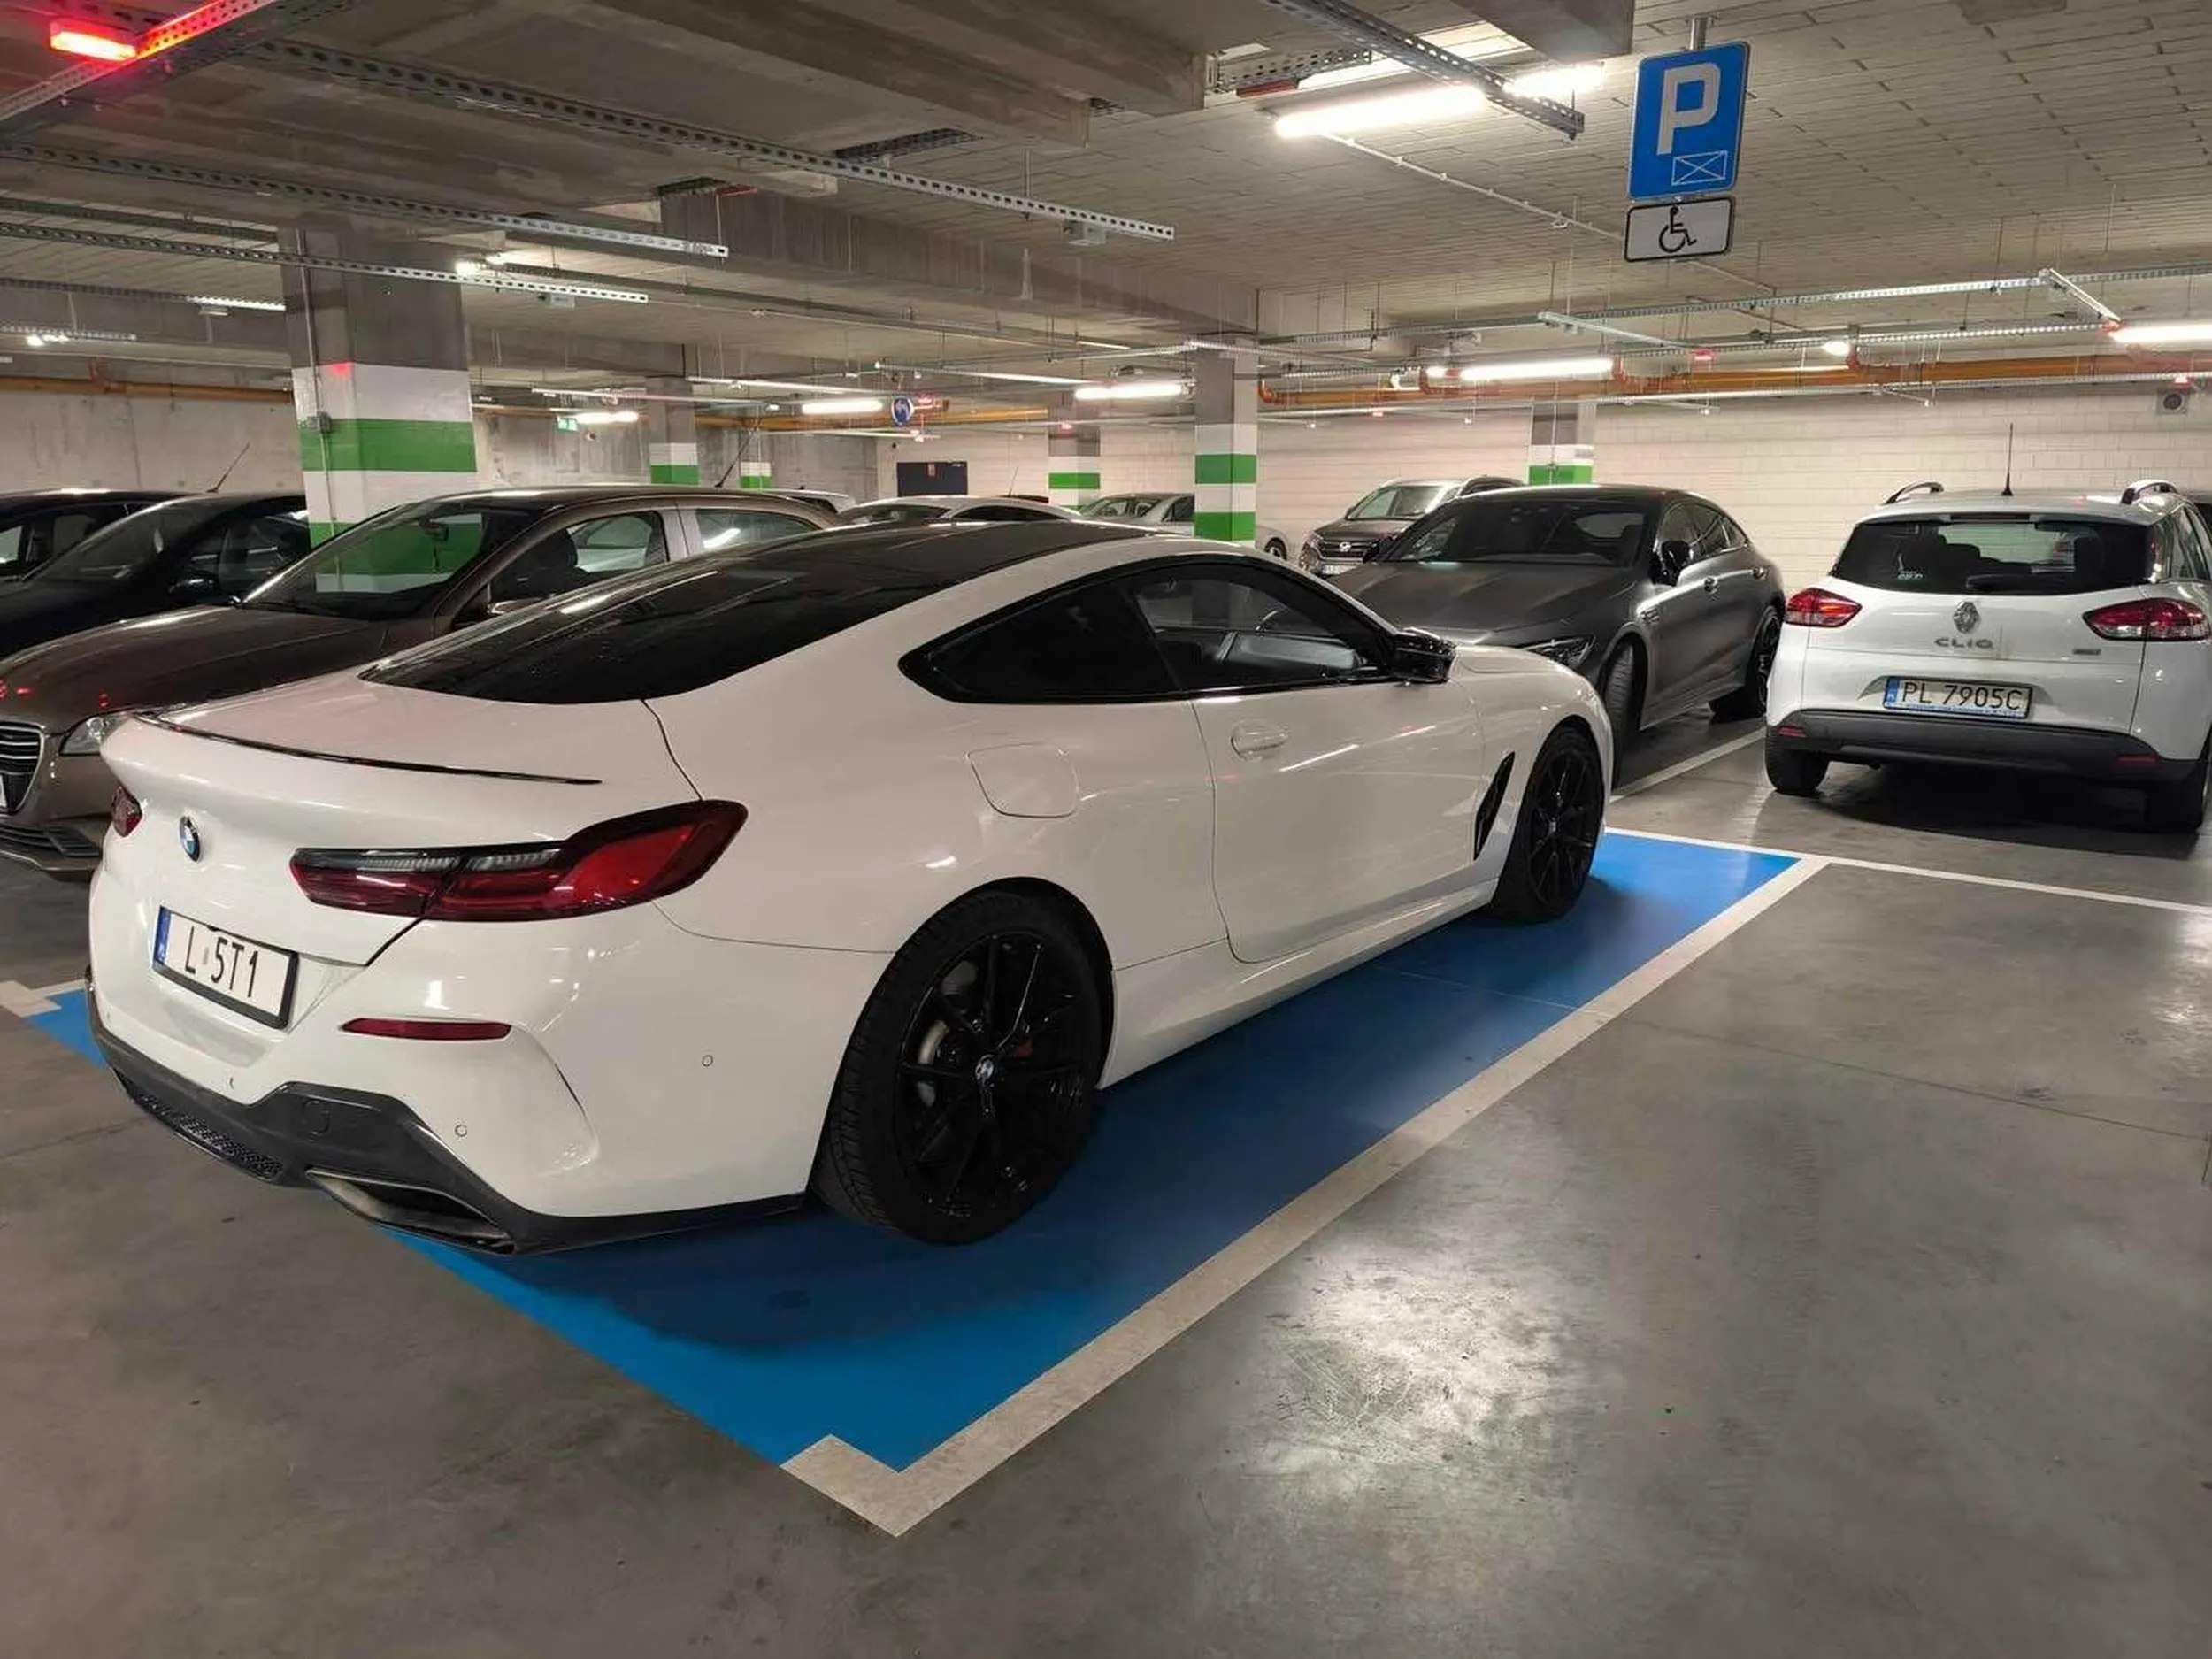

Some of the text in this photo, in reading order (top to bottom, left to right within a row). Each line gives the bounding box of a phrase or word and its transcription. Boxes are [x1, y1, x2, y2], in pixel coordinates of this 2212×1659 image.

[1656, 62, 1721, 156] P
[1934, 637, 1994, 649] CLIO
[1902, 681, 2024, 710] PL 7905C
[185, 926, 196, 974] L
